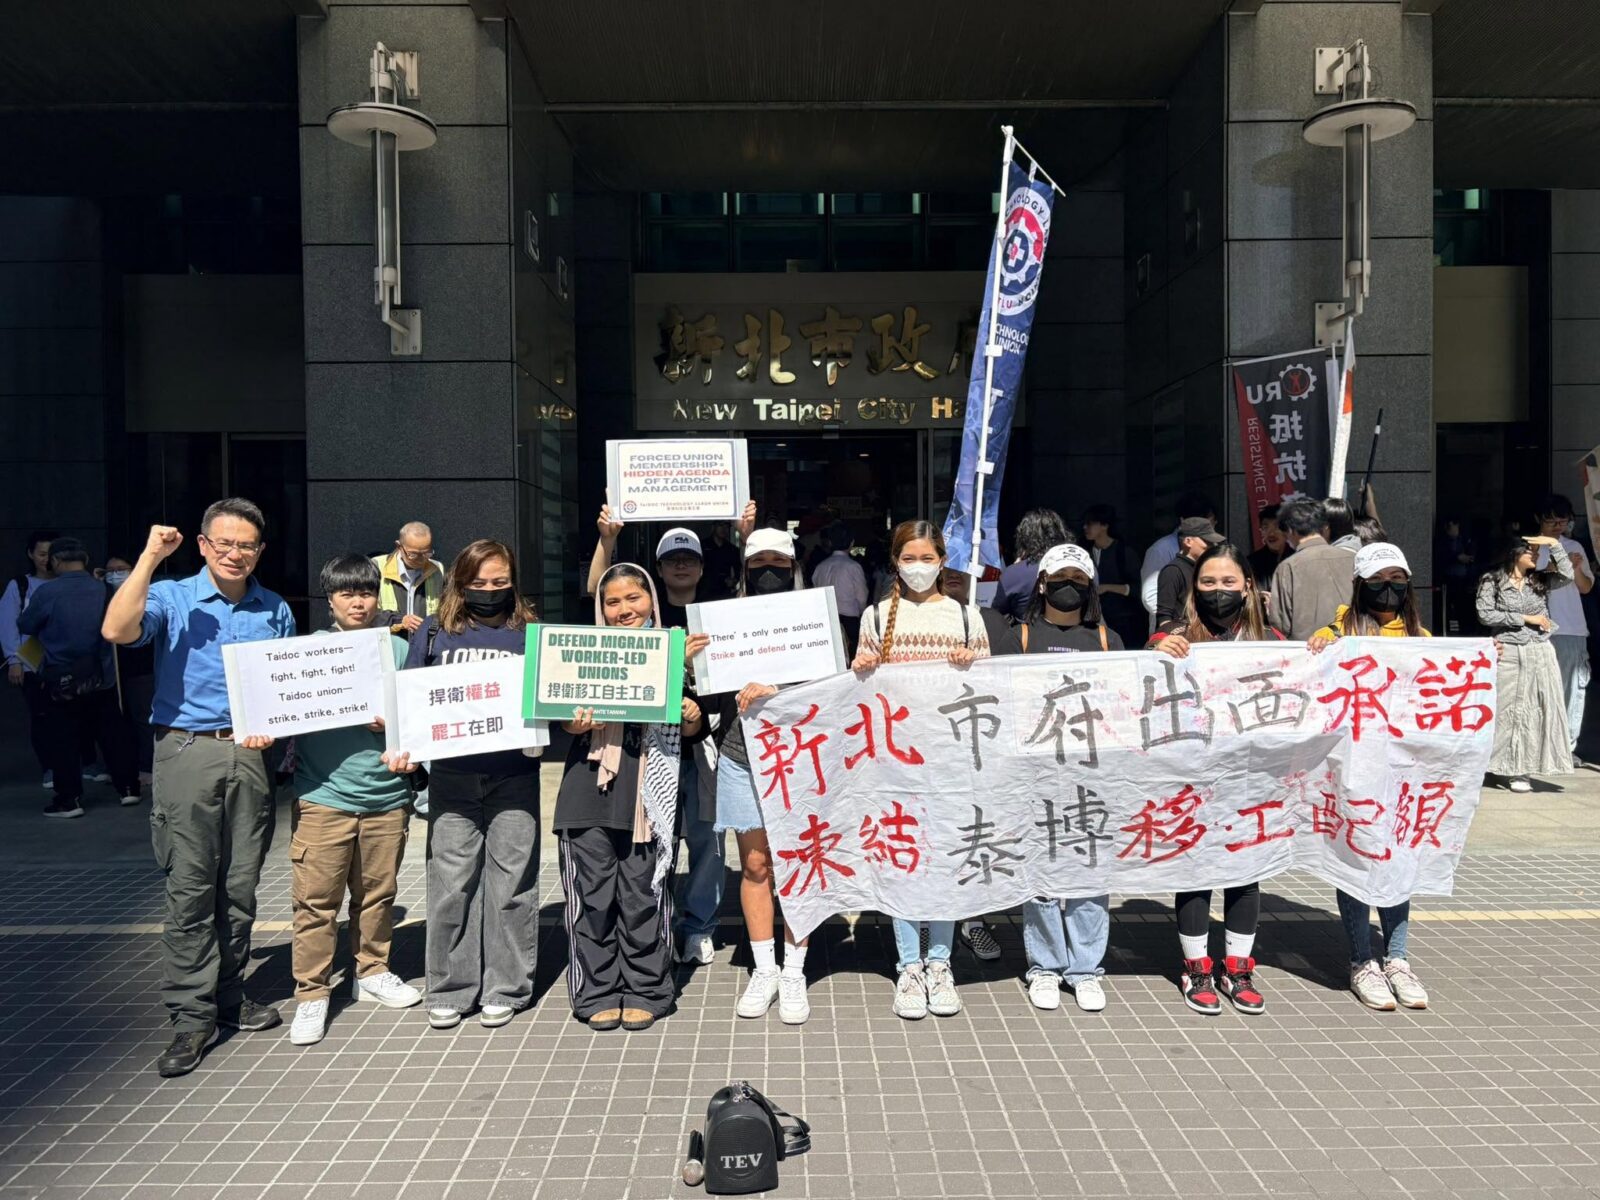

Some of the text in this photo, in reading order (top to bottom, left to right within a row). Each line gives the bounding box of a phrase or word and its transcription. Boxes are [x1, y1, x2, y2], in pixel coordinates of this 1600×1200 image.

[672, 397, 965, 424] New Taipei City Ha
[629, 453, 724, 462] FORCED UNION
[629, 461, 718, 470] MEMBERSHIP
[623, 469, 731, 478] HIDDEN AGENDA
[644, 477, 710, 485] OF TAIDOC
[628, 484, 728, 493] MANAGEMENT!
[752, 628, 769, 638] only
[773, 627, 789, 635] one
[792, 621, 824, 632] solution
[548, 633, 662, 650] DEFEND MIGRANT
[710, 639, 829, 661] Strike and defend our union
[266, 651, 300, 662] Taidoc
[441, 648, 523, 666] LOND
[561, 650, 647, 665] WORKER-LED
[270, 664, 356, 683] fight, fight, fight!
[577, 666, 629, 680] UNIONS
[279, 691, 312, 702] Taidoc
[428, 681, 501, 706] 捍衛權益
[547, 682, 656, 701] 捍衛移工自主工會
[268, 702, 369, 725] strike, strike, strike!
[431, 716, 504, 741] 罷工在即
[753, 650, 1494, 811] 新北市府出面承諾
[720, 1152, 763, 1169] TEV
